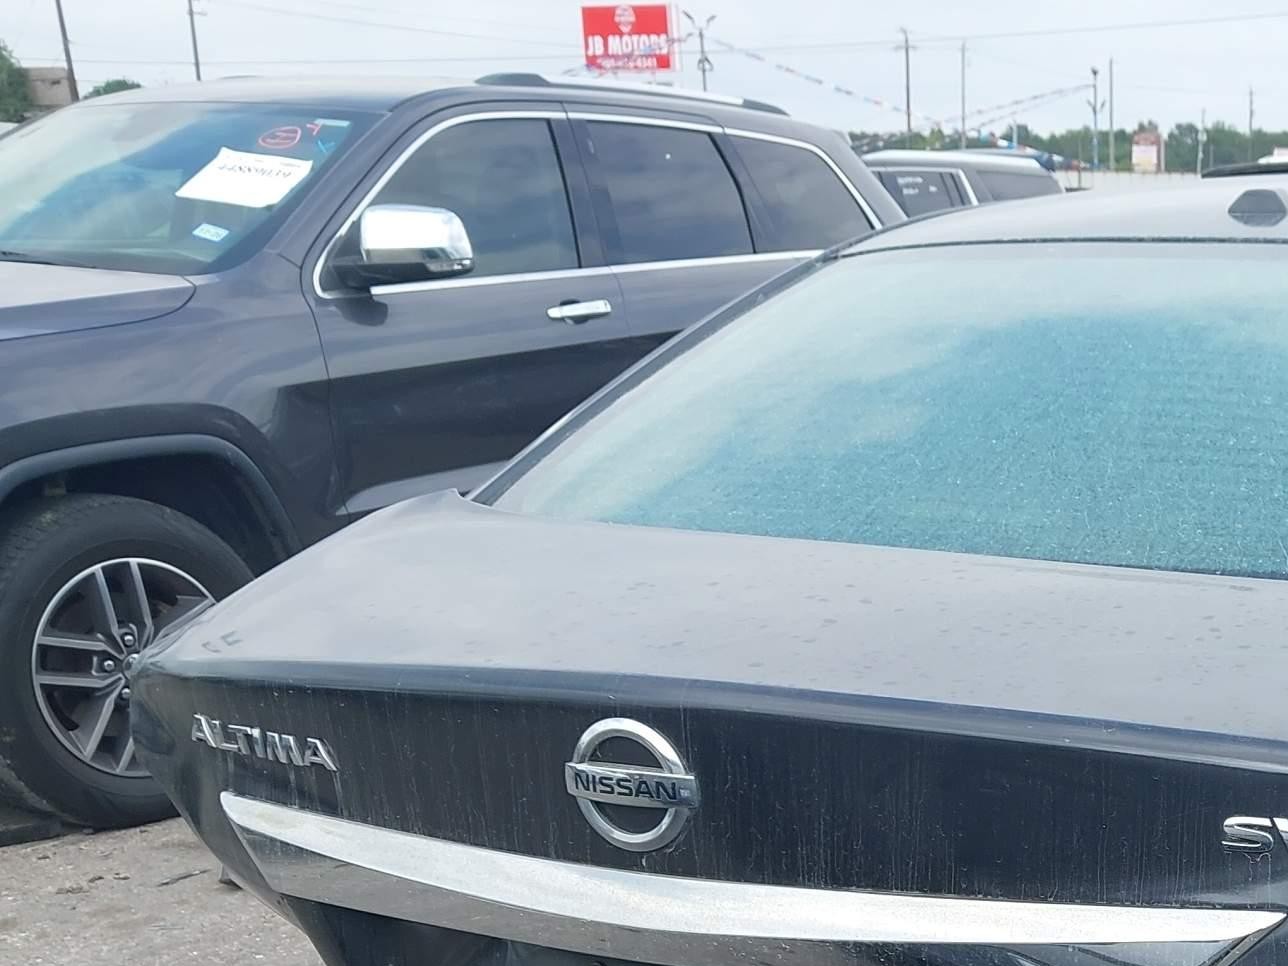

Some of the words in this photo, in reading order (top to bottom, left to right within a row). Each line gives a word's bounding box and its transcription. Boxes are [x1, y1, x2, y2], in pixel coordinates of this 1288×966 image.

[587, 34, 605, 56] JB
[607, 32, 669, 56] MOTORS
[191, 713, 340, 772] ALTIMA
[574, 770, 677, 801] NISSAN
